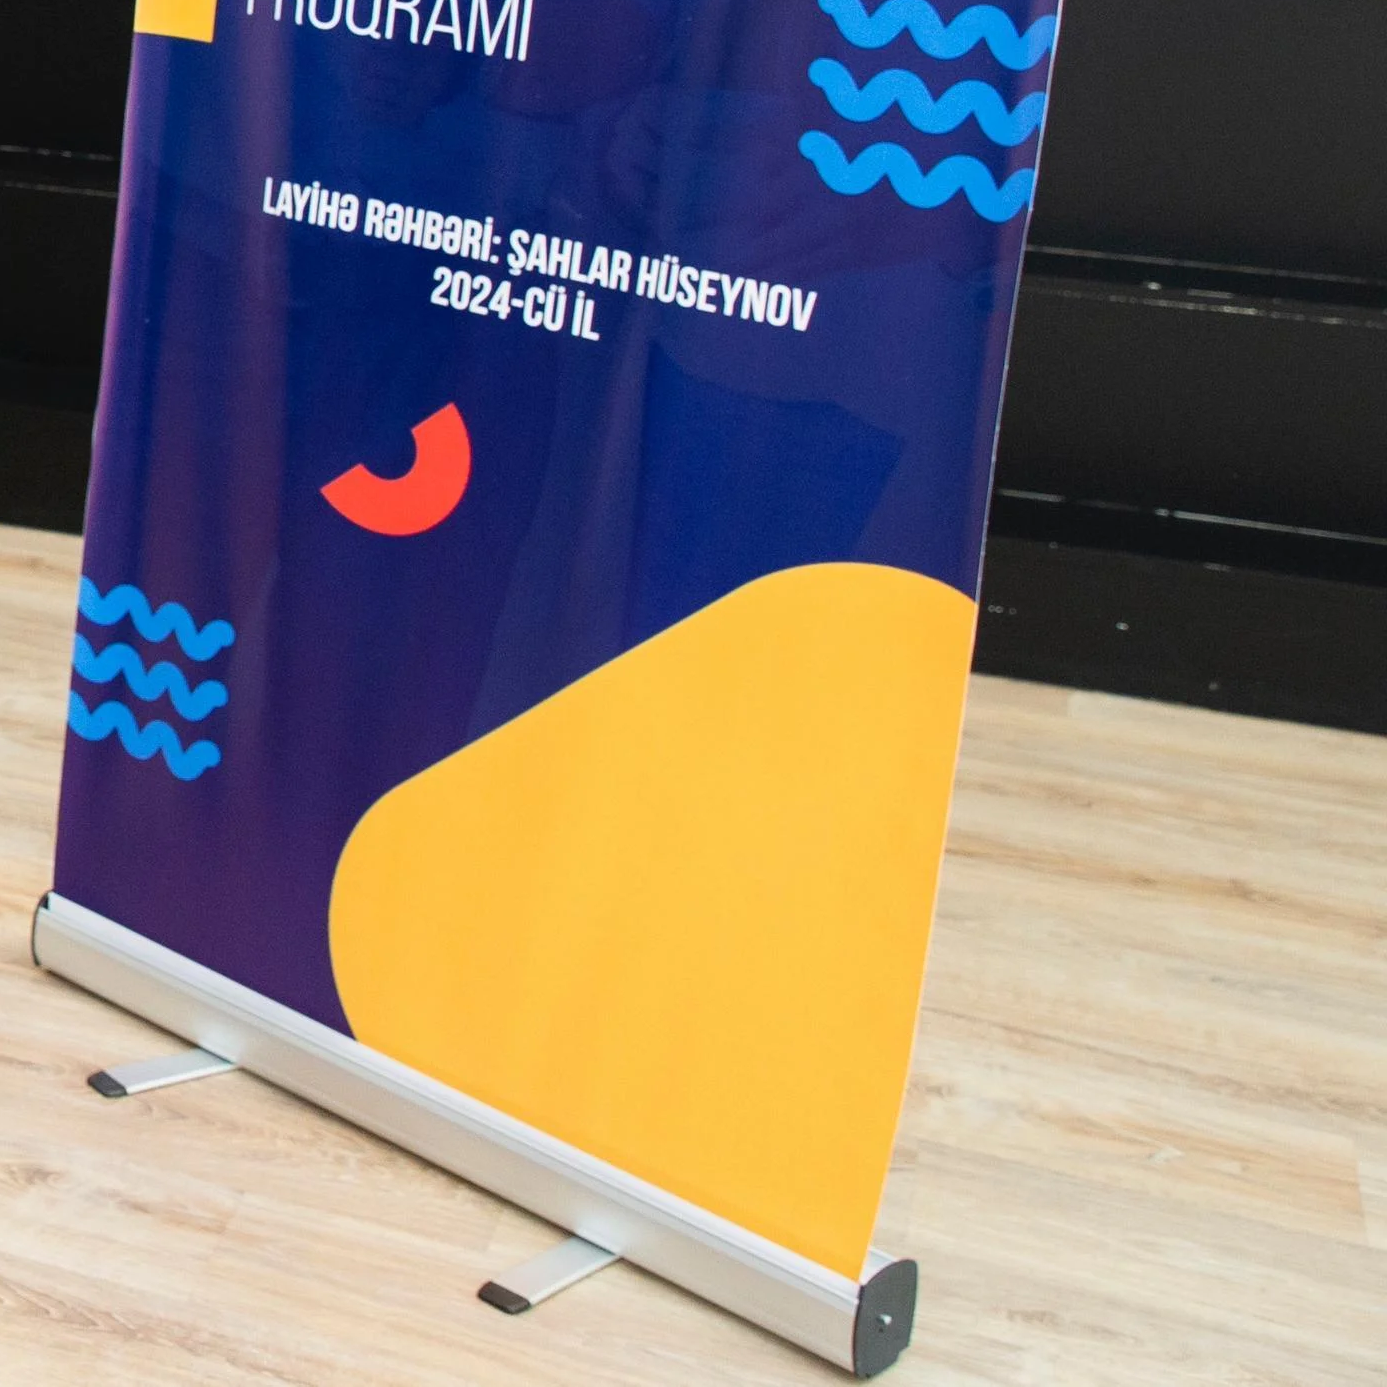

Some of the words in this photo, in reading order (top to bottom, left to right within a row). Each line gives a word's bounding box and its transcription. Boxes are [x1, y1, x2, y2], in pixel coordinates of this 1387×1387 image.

[262, 176, 357, 234] LAYİHƏ
[363, 198, 501, 264] RƏHBƏRİ:
[507, 229, 631, 293] ŞAHLAR
[636, 254, 819, 333] HÜSEYNOV
[430, 266, 568, 333] 2024-CÜ
[571, 298, 601, 342] İL
